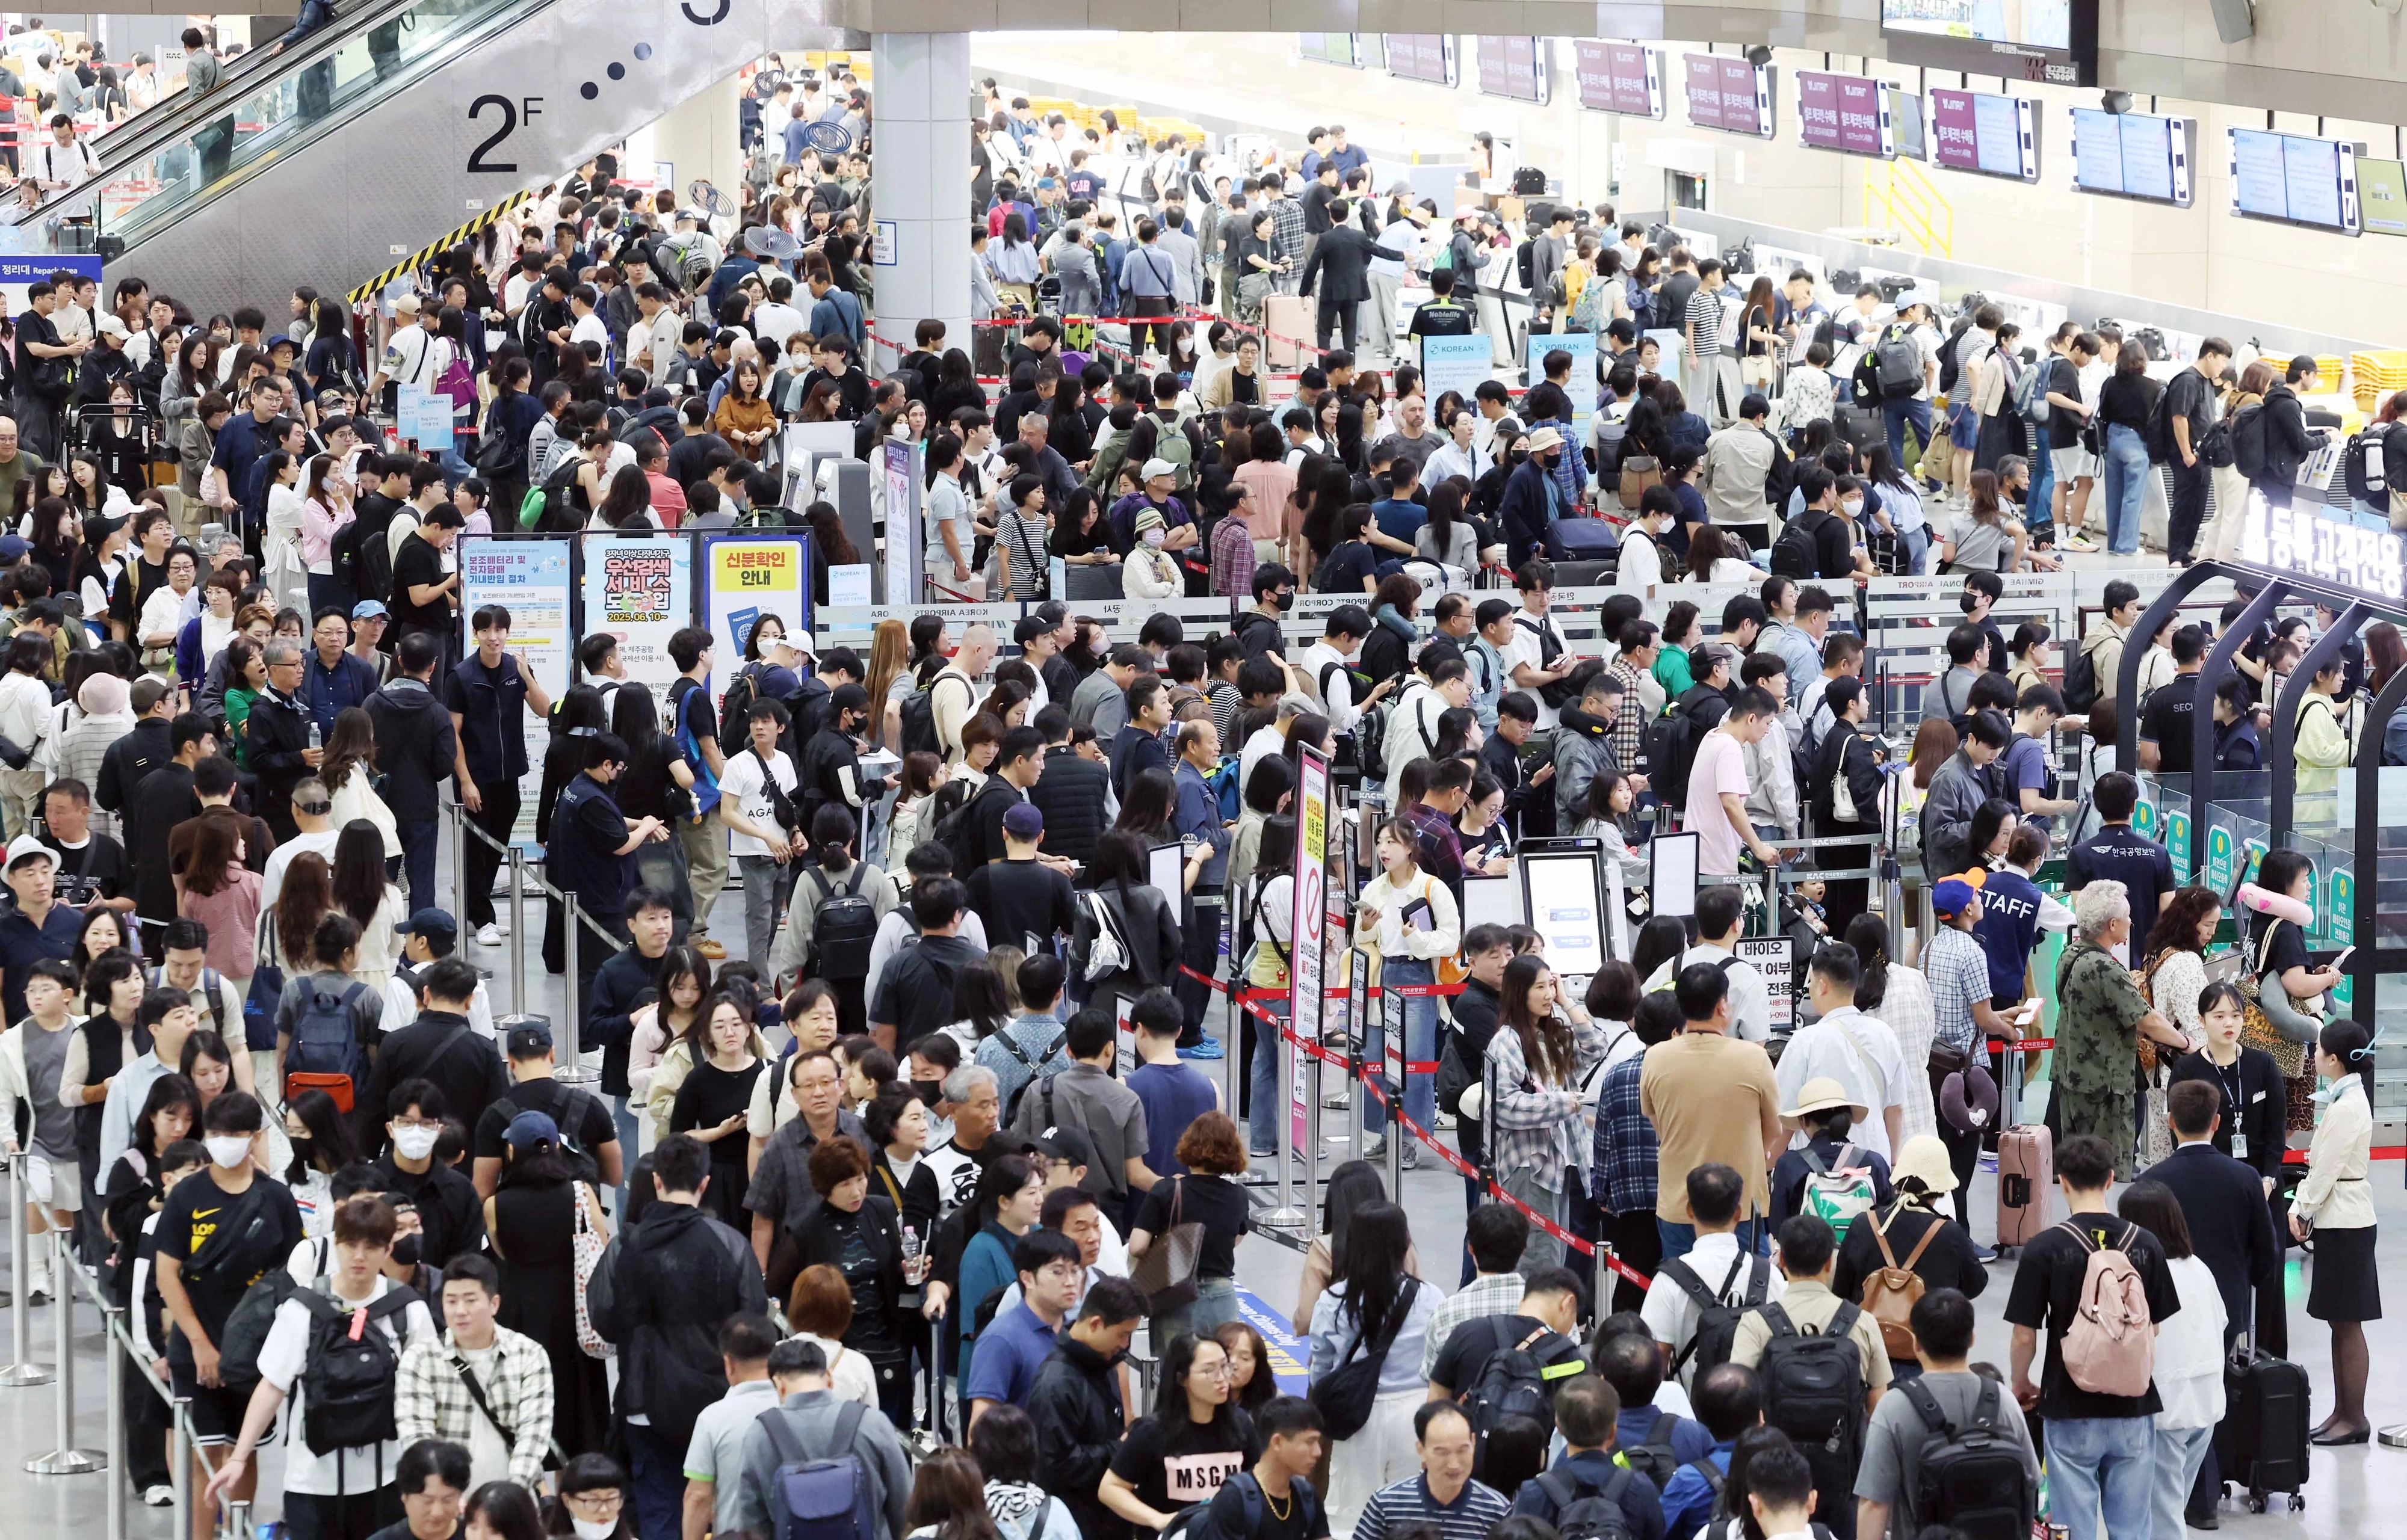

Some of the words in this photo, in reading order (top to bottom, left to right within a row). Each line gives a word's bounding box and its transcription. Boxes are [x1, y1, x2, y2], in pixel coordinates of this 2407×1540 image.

[2345, 192, 2355, 219] 7
[2, 265, 29, 275] 정리대
[33, 267, 59, 276] Repack
[1545, 343, 1579, 351] KOREAN
[469, 555, 514, 565] 보조배터리
[518, 555, 526, 564] 및
[605, 549, 623, 558] 3자녀
[624, 549, 637, 558] 이상
[637, 549, 670, 558] 다자녀가구
[726, 552, 785, 568] 신분확인
[469, 565, 505, 574] 전자담배
[605, 558, 670, 577] 우선검색
[469, 574, 505, 584] 기내반입
[508, 574, 526, 584] 절차
[605, 576, 670, 593] 서비스
[740, 570, 771, 586] 안내
[732, 612, 755, 623] PASSPORT
[2082, 734, 2095, 745] Passe
[748, 807, 773, 818] AGA
[1306, 796, 1323, 821] 바이오패스
[2112, 846, 2155, 858] 한국공항보안
[2174, 842, 2183, 854] 여권
[1977, 890, 2034, 919] TAFF
[2338, 901, 2347, 915] 여권
[2332, 913, 2352, 931] 바이오인증
[2334, 927, 2350, 944] 전용통로
[1744, 941, 1783, 956] 바이오
[1750, 963, 1762, 975] 록
[1766, 961, 1791, 975] 여부
[1767, 981, 1793, 996] 전용
[1387, 996, 1400, 1015] 바이오
[1385, 1018, 1401, 1040] 고객전용
[1119, 1061, 1134, 1074] Entranc
[1367, 1064, 1382, 1073] KA
[1273, 1333, 1301, 1347] Only
